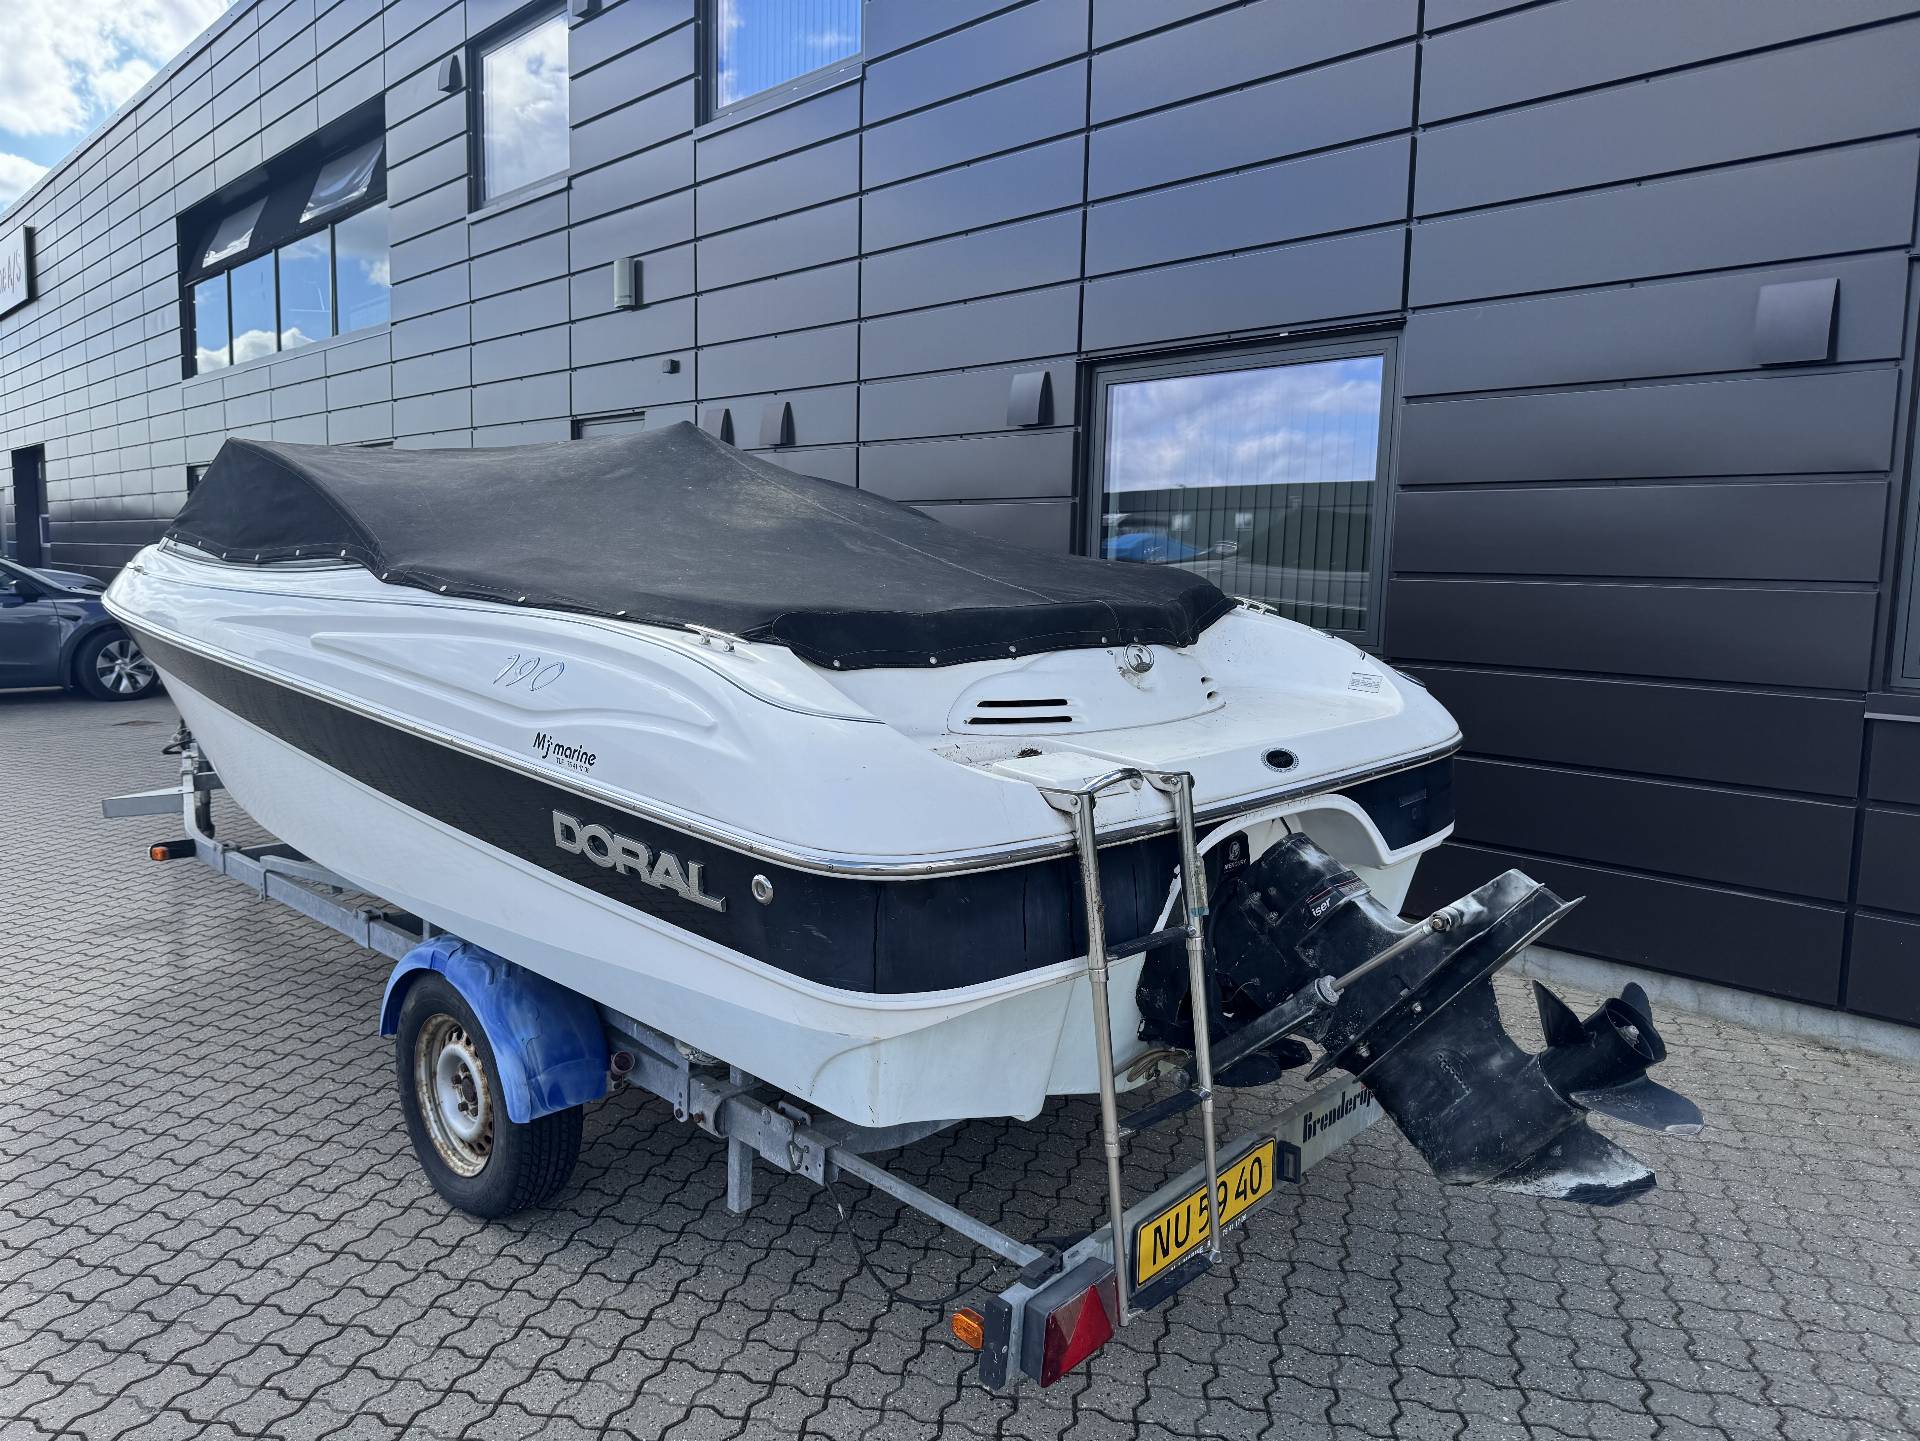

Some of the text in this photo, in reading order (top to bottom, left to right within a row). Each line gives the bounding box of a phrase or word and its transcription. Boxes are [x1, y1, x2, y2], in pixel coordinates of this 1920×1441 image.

[493, 654, 565, 691] 190
[553, 743, 597, 766] marine
[552, 808, 727, 913] DORAL
[1311, 897, 1331, 917] iser
[1152, 1156, 1263, 1266] NU 59 40
